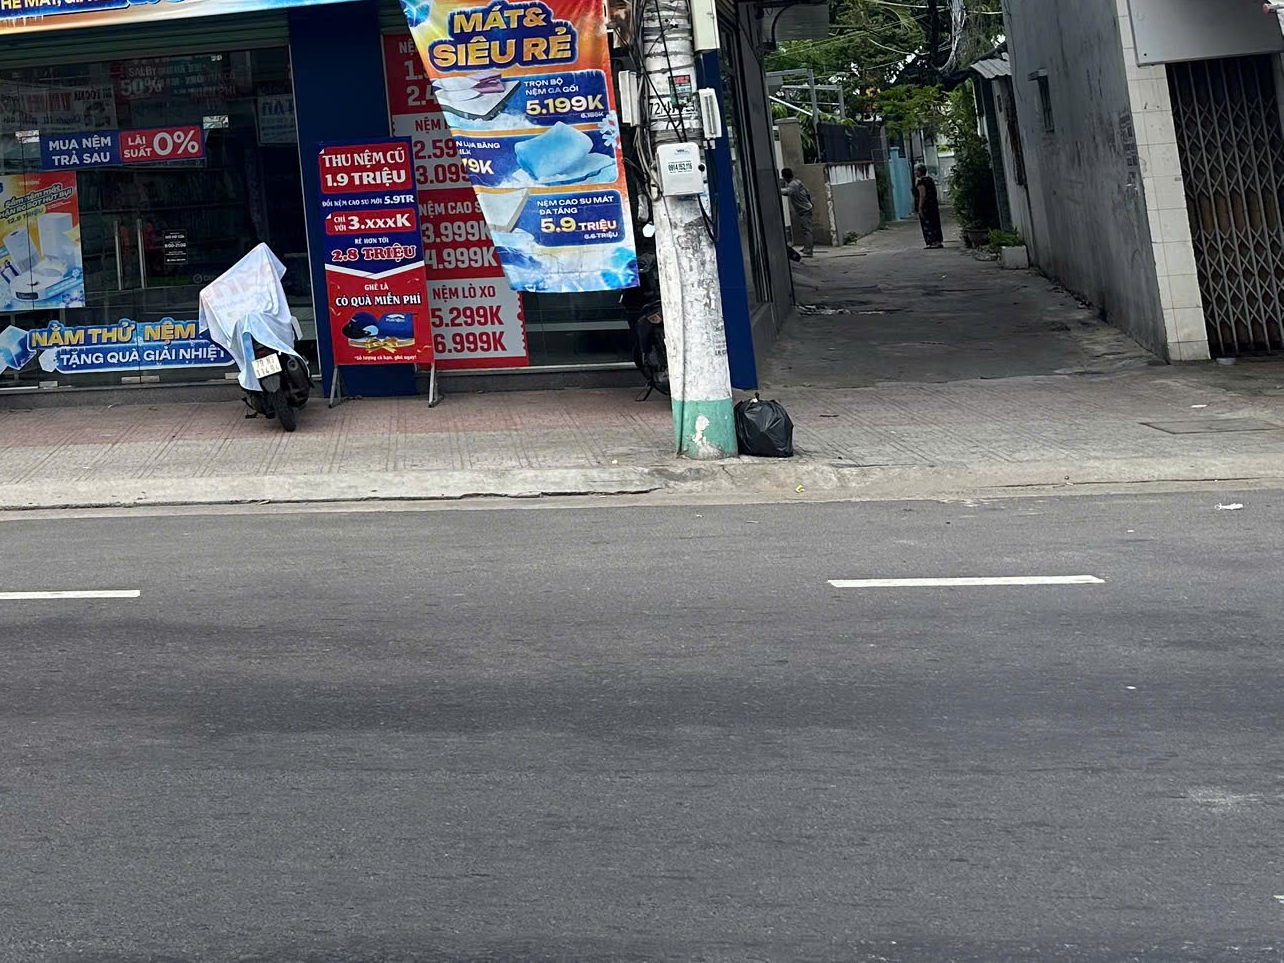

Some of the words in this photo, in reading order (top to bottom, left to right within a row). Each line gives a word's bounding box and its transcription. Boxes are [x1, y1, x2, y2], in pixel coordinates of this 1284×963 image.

[524, 79, 548, 89] TRỌN
[550, 77, 564, 87] BỘ
[525, 87, 547, 97] NỆM
[548, 86, 562, 95] GA
[525, 94, 604, 115] 5.199K
[49, 139, 79, 151] MUA
[82, 135, 112, 151] NỆM
[128, 134, 146, 146] LÃI
[153, 129, 199, 157] 0%
[52, 150, 80, 166] TRẢ
[83, 151, 111, 165] SAU
[123, 146, 152, 159] SUẤT
[323, 154, 352, 168] THU
[354, 149, 384, 167] NỆM
[386, 146, 405, 163] CŨ
[325, 173, 349, 187] 1.9
[351, 167, 406, 186] TRIỆU
[419, 199, 446, 219] NỆM
[448, 201, 473, 215] CAO
[537, 199, 557, 208] NỆM
[559, 198, 578, 206] CAO
[593, 195, 615, 204] MÁT
[540, 216, 577, 233] 5.9
[578, 218, 617, 232] TRIỆU
[331, 248, 359, 262] 2.8
[361, 242, 417, 263] TRIỆU
[335, 294, 348, 306] CÓ
[351, 294, 372, 307] QUÀ
[374, 292, 401, 305] MIỄN
[403, 292, 421, 305] PHÍ
[432, 284, 460, 302] NỆM
[462, 282, 478, 298] LÒ
[480, 285, 496, 298] XO
[430, 305, 505, 329] 5.299K
[433, 330, 508, 354] 6.999K
[60, 350, 104, 368] TẶNG
[106, 348, 141, 364] QUÀ
[143, 346, 176, 361] GIẢI
